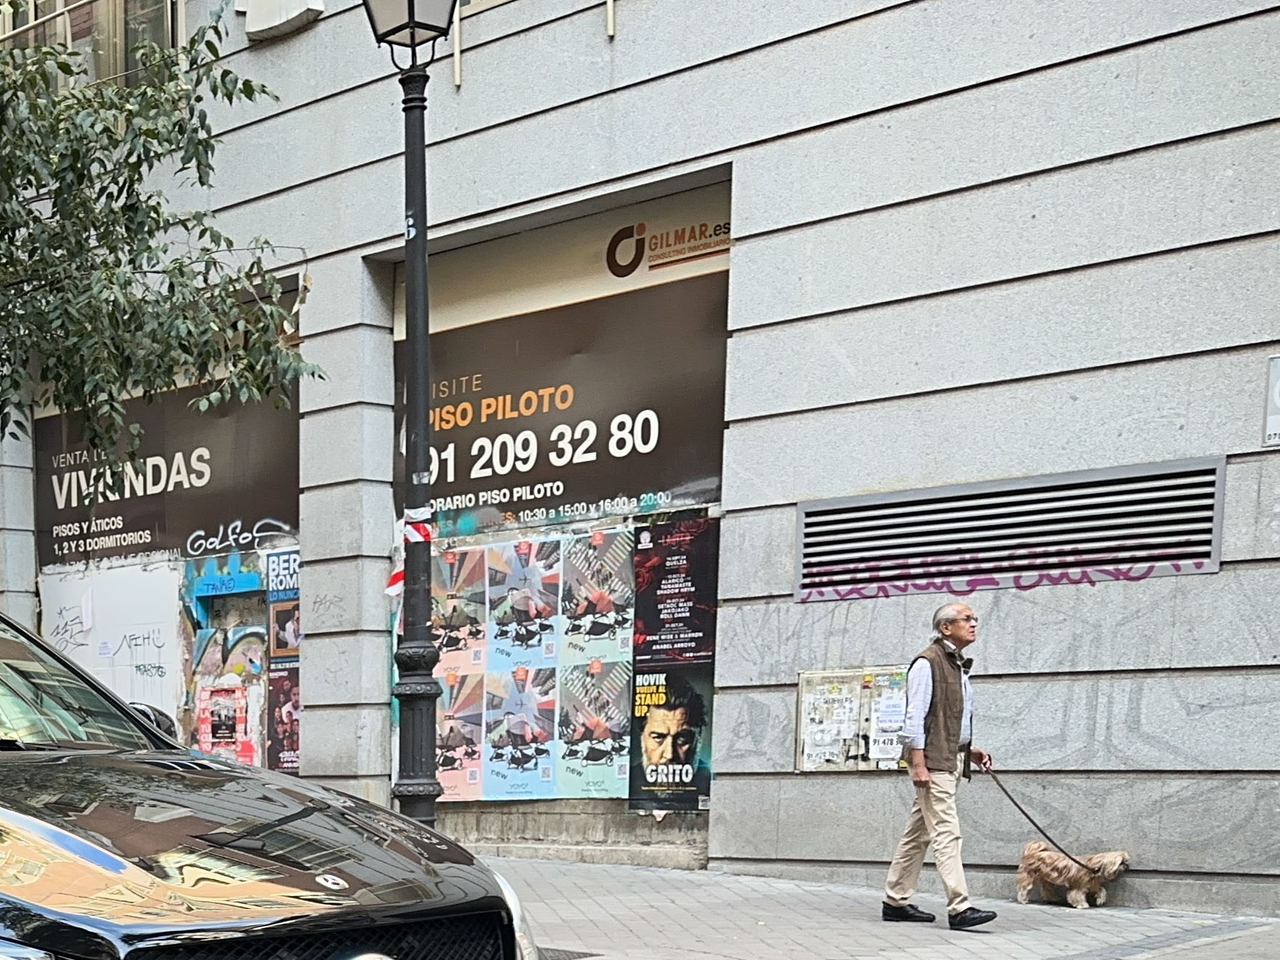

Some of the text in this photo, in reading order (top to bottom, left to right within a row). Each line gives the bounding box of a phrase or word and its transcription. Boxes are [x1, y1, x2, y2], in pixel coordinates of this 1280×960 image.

[432, 373, 483, 399] ISITE
[481, 384, 574, 423] PILOTO
[470, 430, 538, 479] 209
[548, 419, 598, 467] 32
[608, 409, 659, 457] 80
[52, 450, 90, 468] VENTA
[429, 481, 564, 513] ORARIO PISO PILOTO
[518, 508, 547, 523] 10:30
[549, 507, 556, 519] a
[559, 501, 588, 517] 15:00
[590, 501, 597, 516] y
[598, 496, 629, 512] 16:00
[630, 498, 638, 508] a
[640, 490, 671, 507] 20:00
[53, 516, 124, 538] PISOS Y ÁTICOS
[63, 541, 70, 554] 2
[69, 540, 79, 552] Y
[78, 539, 86, 551] 3
[86, 529, 152, 551] DORMITORIOS
[269, 573, 300, 591] ROM
[495, 646, 512, 658] new
[567, 641, 586, 653] new
[636, 673, 667, 686] HOVIK
[658, 685, 666, 693] AL
[635, 692, 667, 706] STAND
[634, 705, 650, 717] UP.
[490, 768, 508, 780] new
[566, 765, 584, 778] new
[645, 764, 694, 783] GRITO
